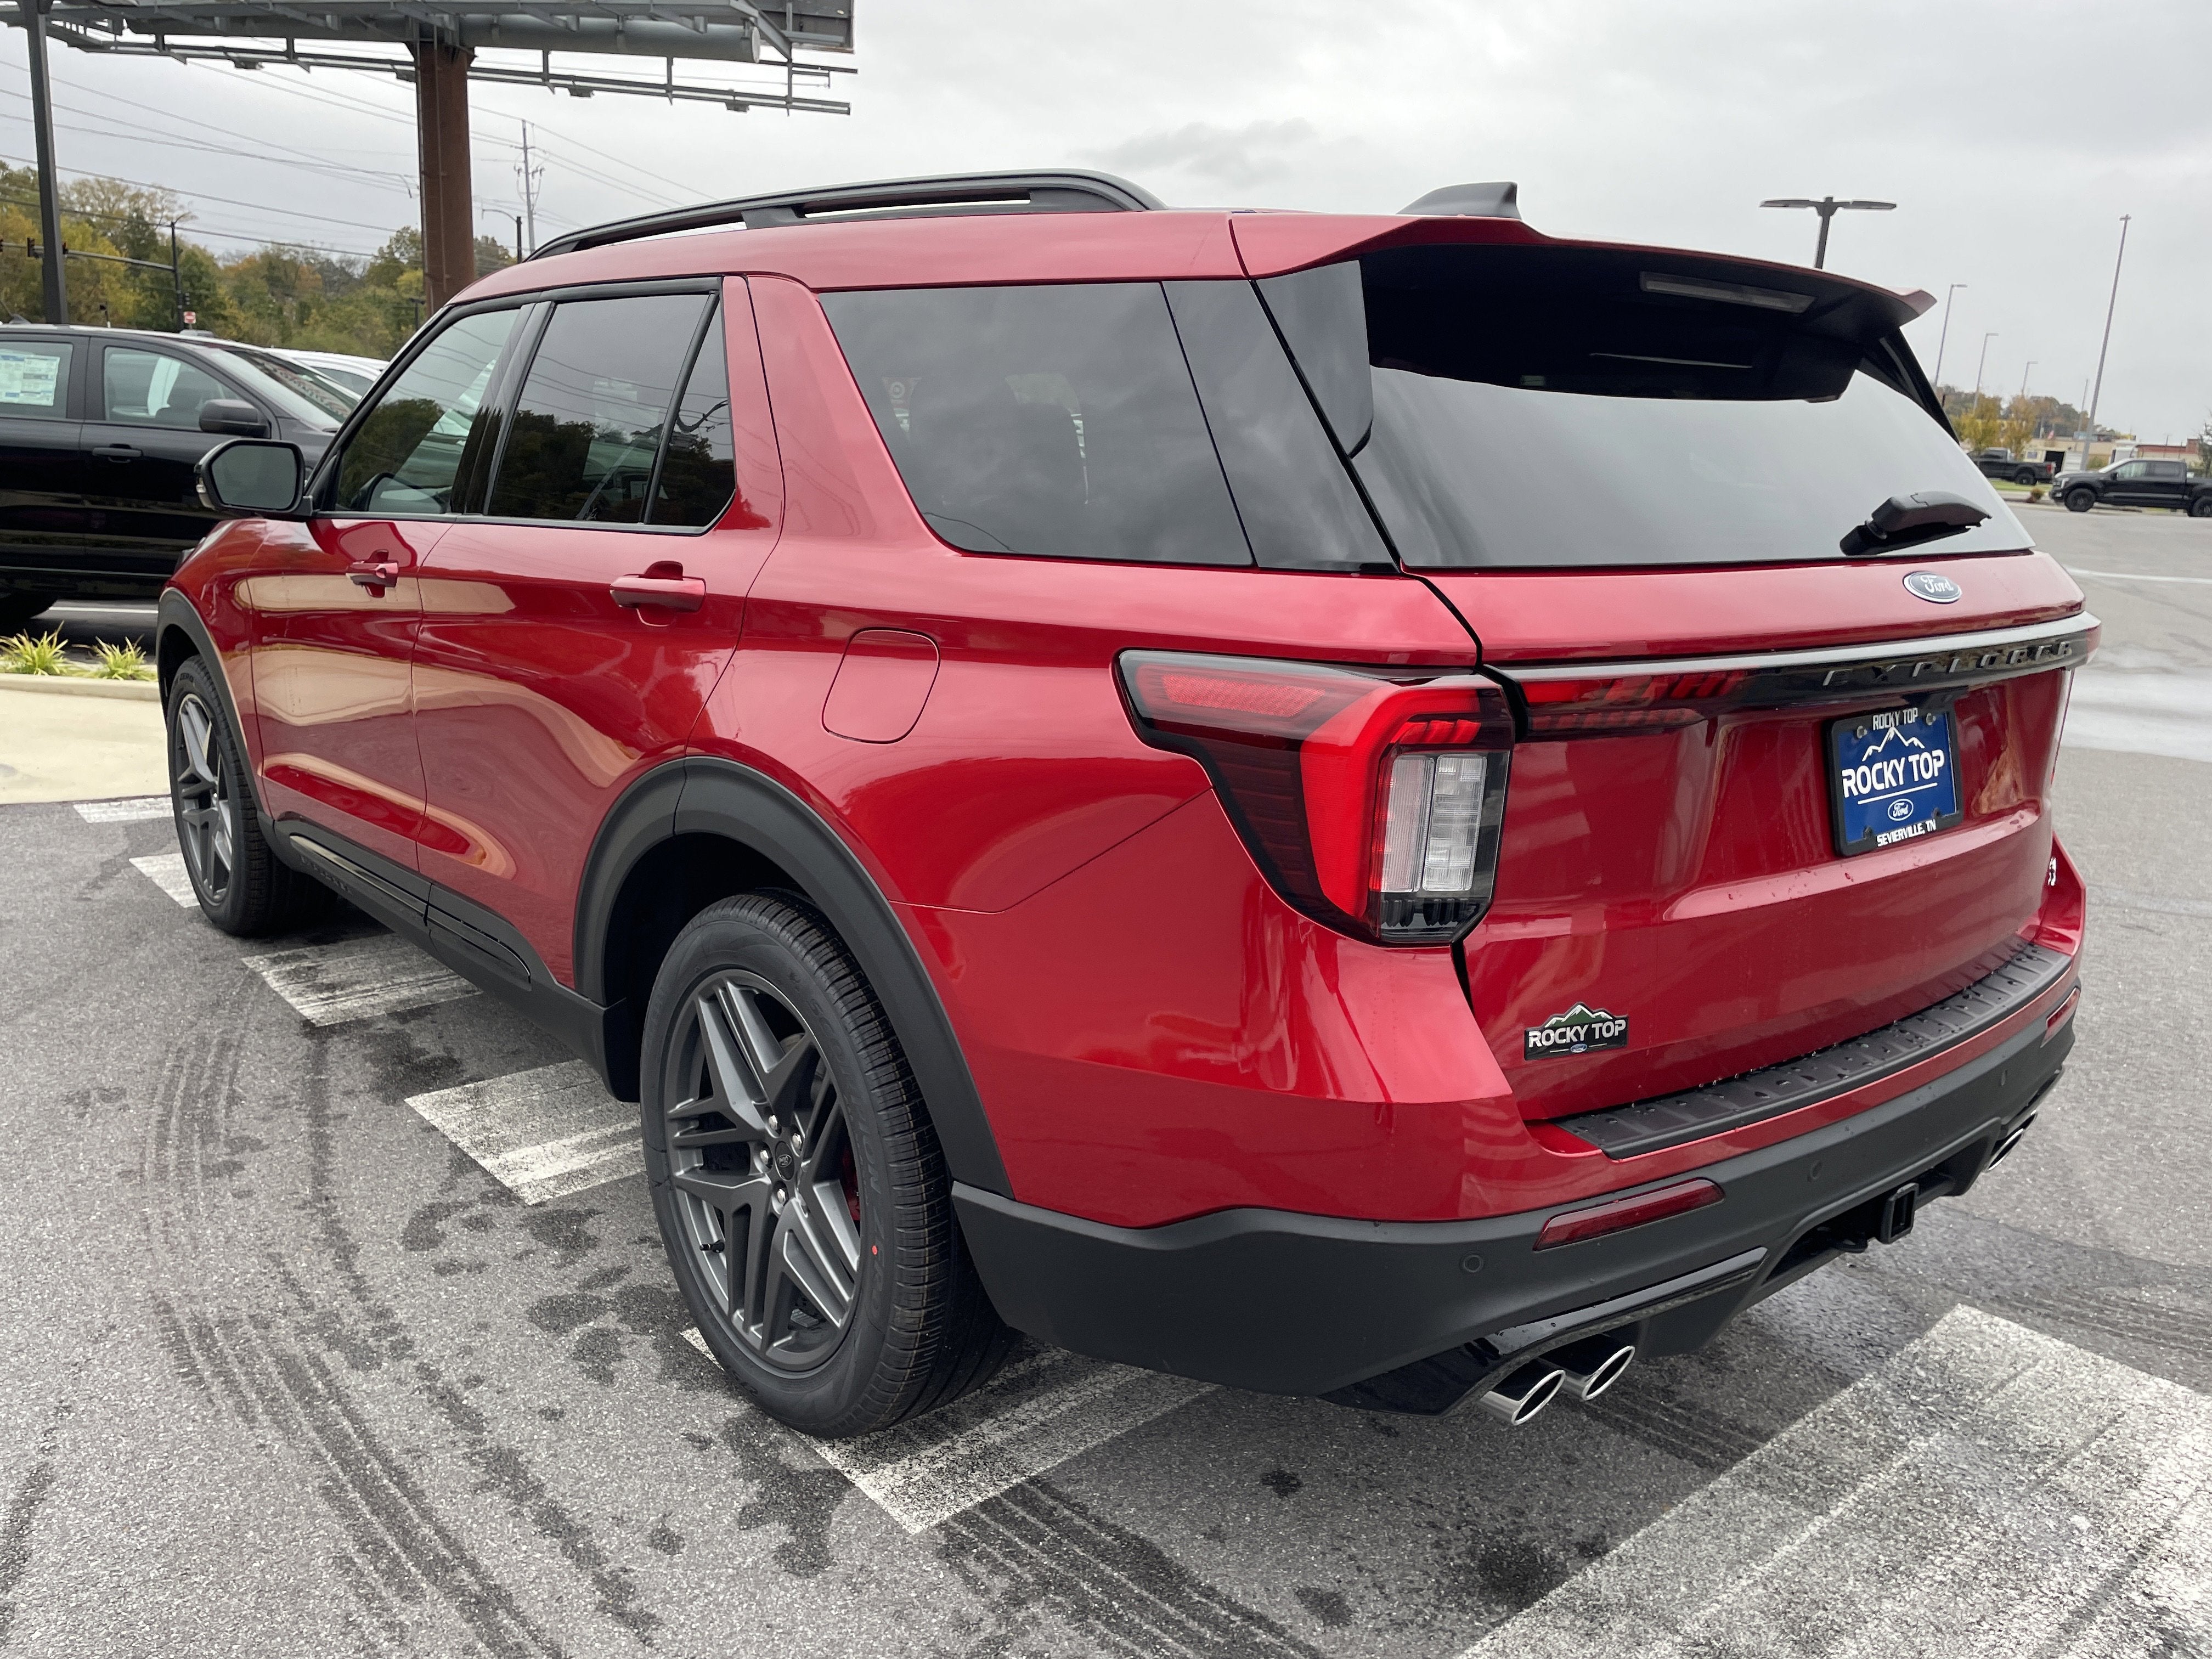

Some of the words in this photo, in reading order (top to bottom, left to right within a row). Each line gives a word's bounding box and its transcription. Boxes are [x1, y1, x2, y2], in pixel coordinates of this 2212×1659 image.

[1920, 573, 1954, 594] Ford
[1822, 641, 2073, 686] EXPLORER
[1872, 712, 1900, 730] ROCKY
[1902, 707, 1918, 724] TOP
[1842, 757, 1905, 798] ROCKY
[1908, 749, 1945, 782] TOP
[1892, 803, 1909, 818] Ford
[1876, 823, 1926, 847] SEVIERVILLE,
[1926, 819, 1936, 831] TN
[1528, 1024, 1589, 1048] ROCKY
[1592, 1019, 1627, 1040] TOP
